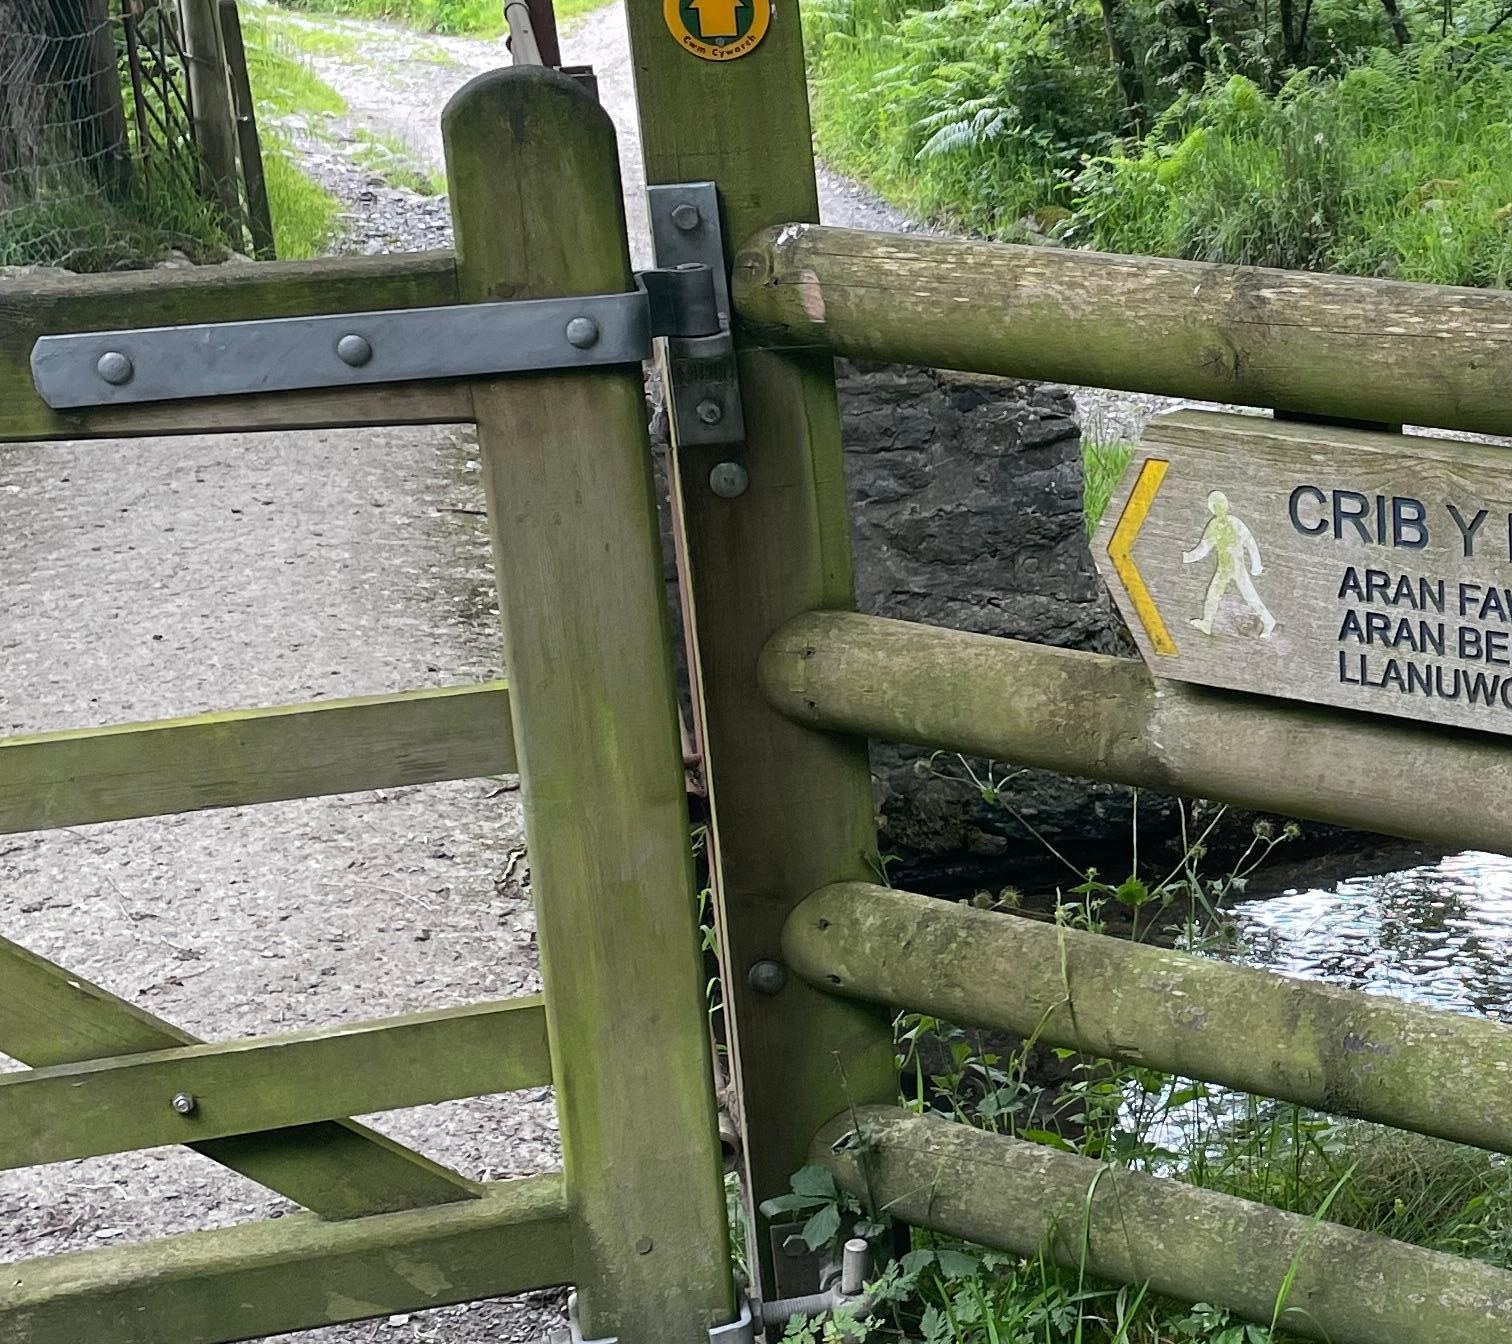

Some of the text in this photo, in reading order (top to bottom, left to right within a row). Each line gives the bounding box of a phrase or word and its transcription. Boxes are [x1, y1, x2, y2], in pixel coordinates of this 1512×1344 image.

[682, 34, 756, 58] Cwm Cywarch
[1288, 484, 1430, 549] CRIB
[1446, 504, 1489, 557] Y
[1337, 566, 1445, 613] ARAN
[1338, 609, 1445, 656] ARAN
